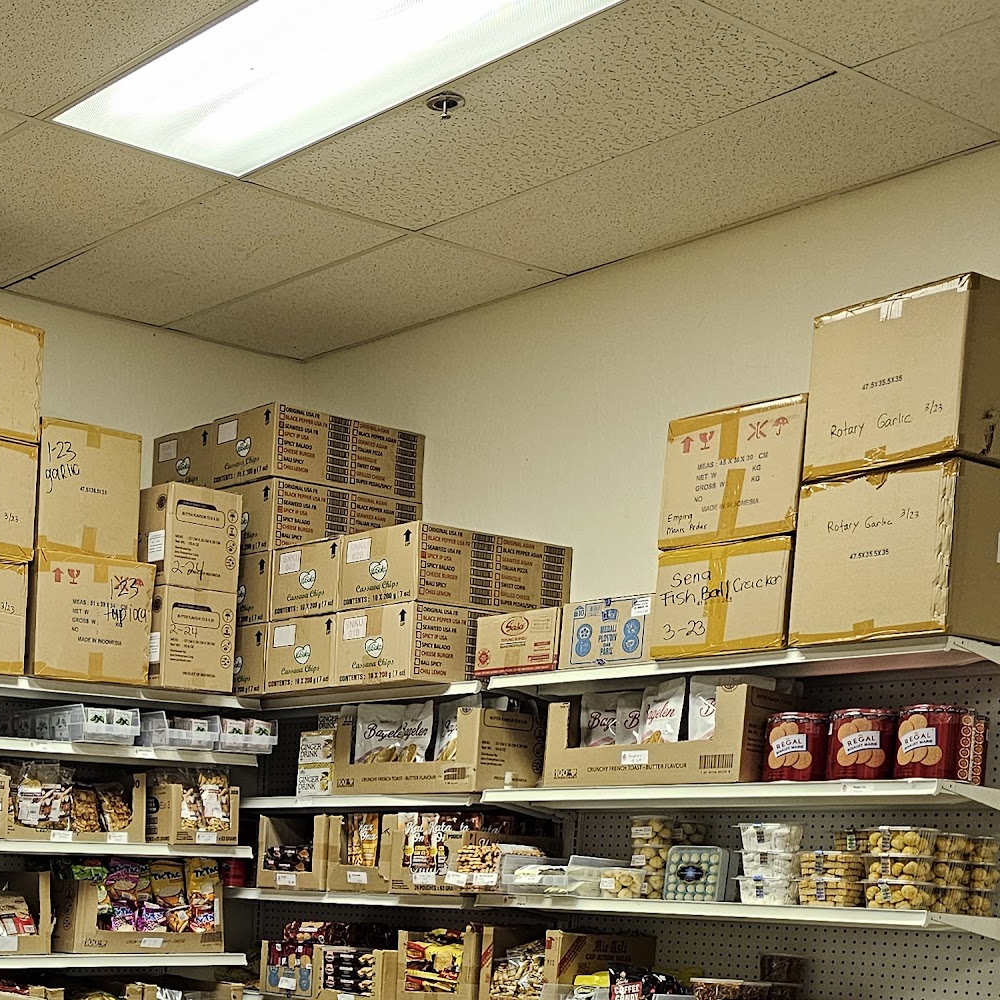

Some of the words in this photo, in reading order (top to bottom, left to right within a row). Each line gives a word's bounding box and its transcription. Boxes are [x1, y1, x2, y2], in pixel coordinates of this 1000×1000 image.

[924, 400, 943, 414] 3/23
[830, 422, 864, 438] Rotary
[877, 412, 912, 429] Garlic
[695, 483, 716, 492] GROSS
[827, 520, 860, 534] Rotary
[900, 507, 919, 520] 3/23
[660, 590, 697, 608] Fish
[847, 735, 876, 747] REGAL
[904, 733, 931, 744] REGAL
[776, 739, 802, 750] REGAL
[300, 750, 318, 758] DRINK
[614, 984, 640, 995] COFFEE
